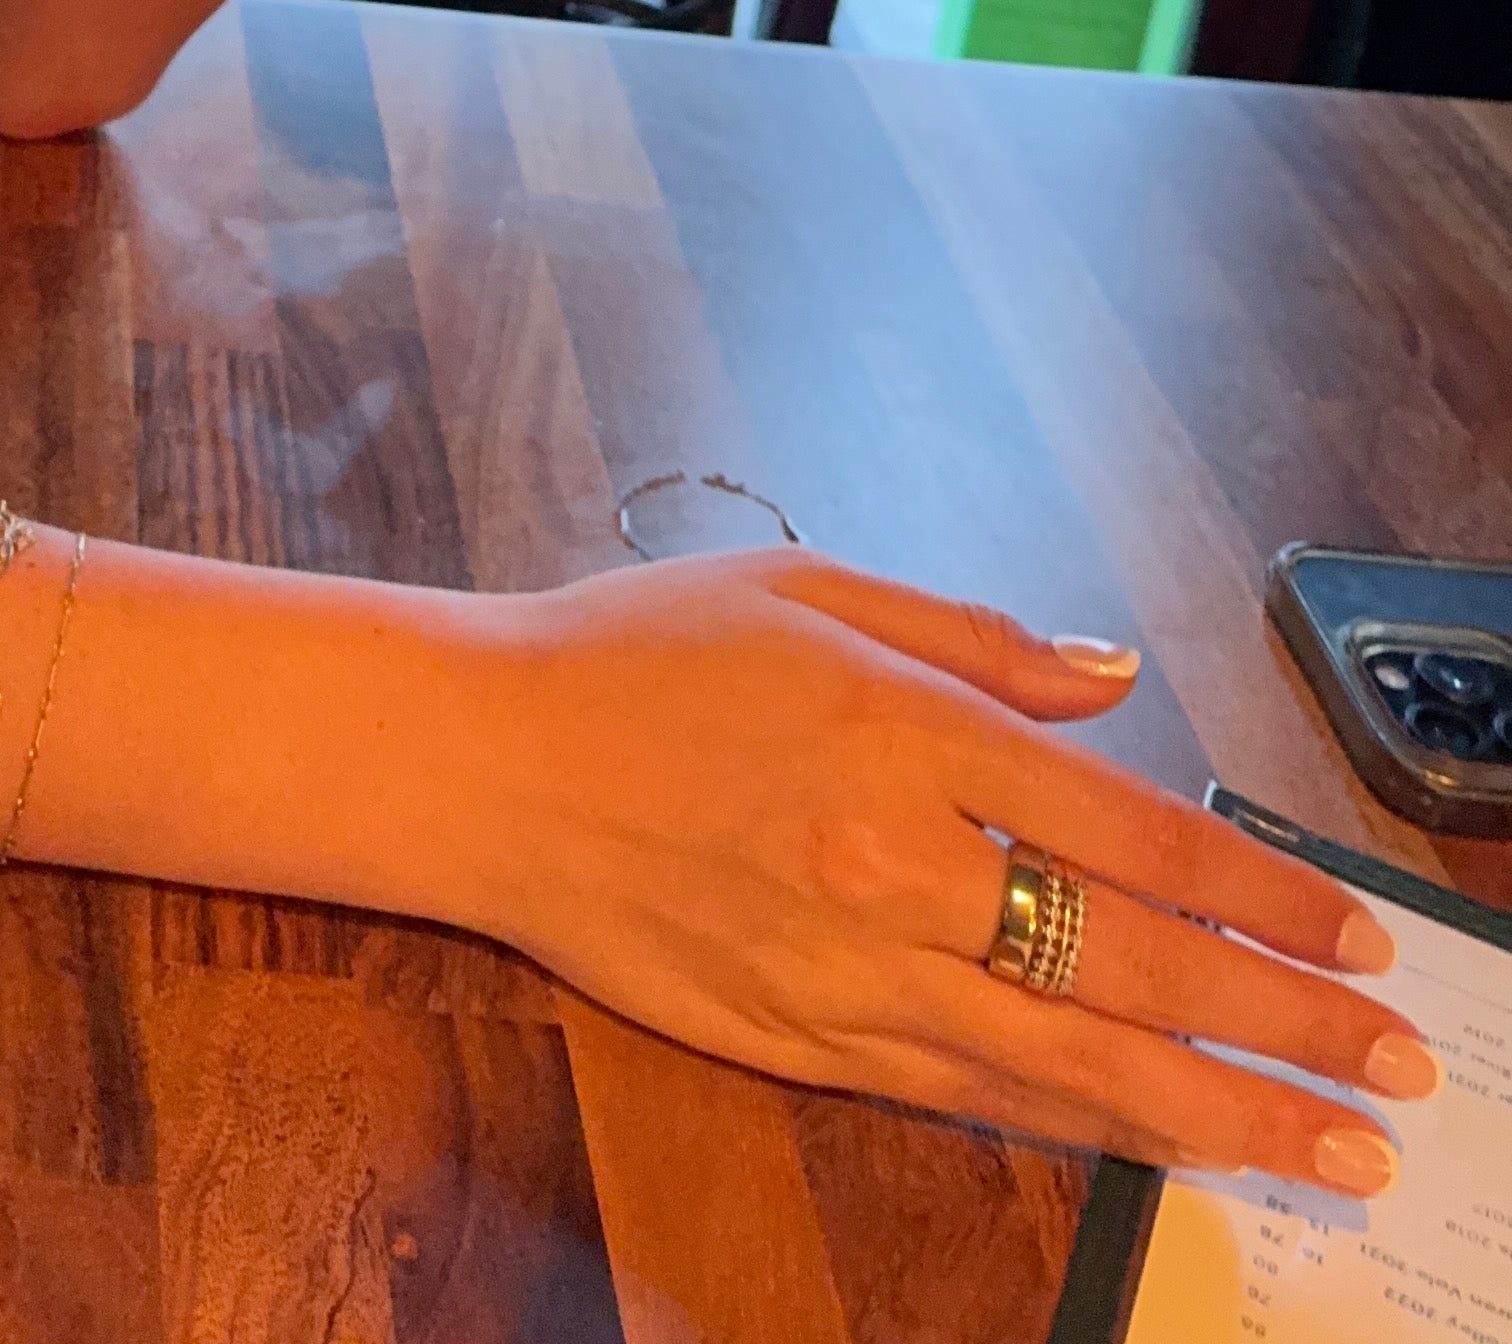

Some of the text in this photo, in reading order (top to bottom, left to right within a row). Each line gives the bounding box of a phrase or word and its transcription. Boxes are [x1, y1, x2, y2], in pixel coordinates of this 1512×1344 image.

[1427, 1035, 1462, 1057] 201
[1360, 1242, 1407, 1275] 2021
[1416, 1270, 1461, 1300] Vale
